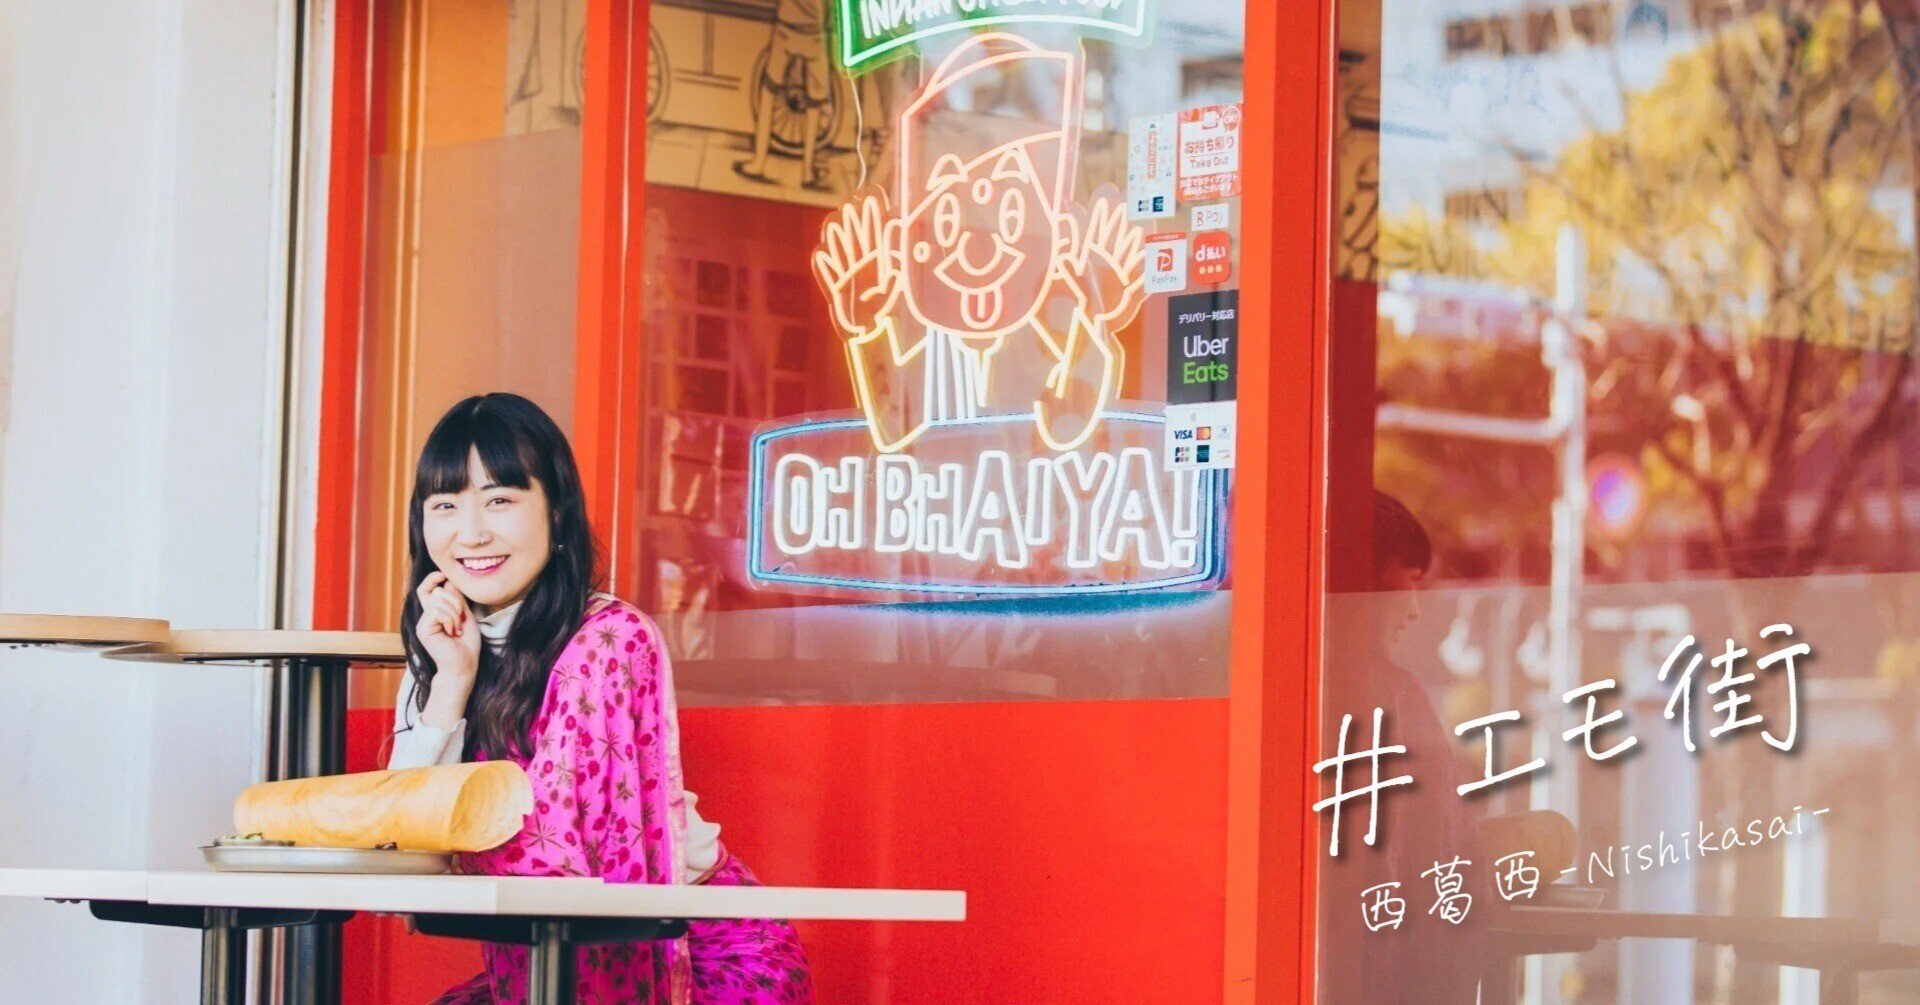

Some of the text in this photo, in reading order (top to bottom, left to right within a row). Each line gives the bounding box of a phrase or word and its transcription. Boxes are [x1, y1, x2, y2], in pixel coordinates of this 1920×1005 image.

[1190, 155, 1229, 168] Take Out
[1195, 244, 1226, 262] d払い
[1179, 309, 1235, 324] デリバリー対応店
[1183, 334, 1229, 358] Uber
[1183, 360, 1229, 384] Eats
[1174, 430, 1193, 440] VISA
[773, 446, 1199, 569] OH BHAIYA!
